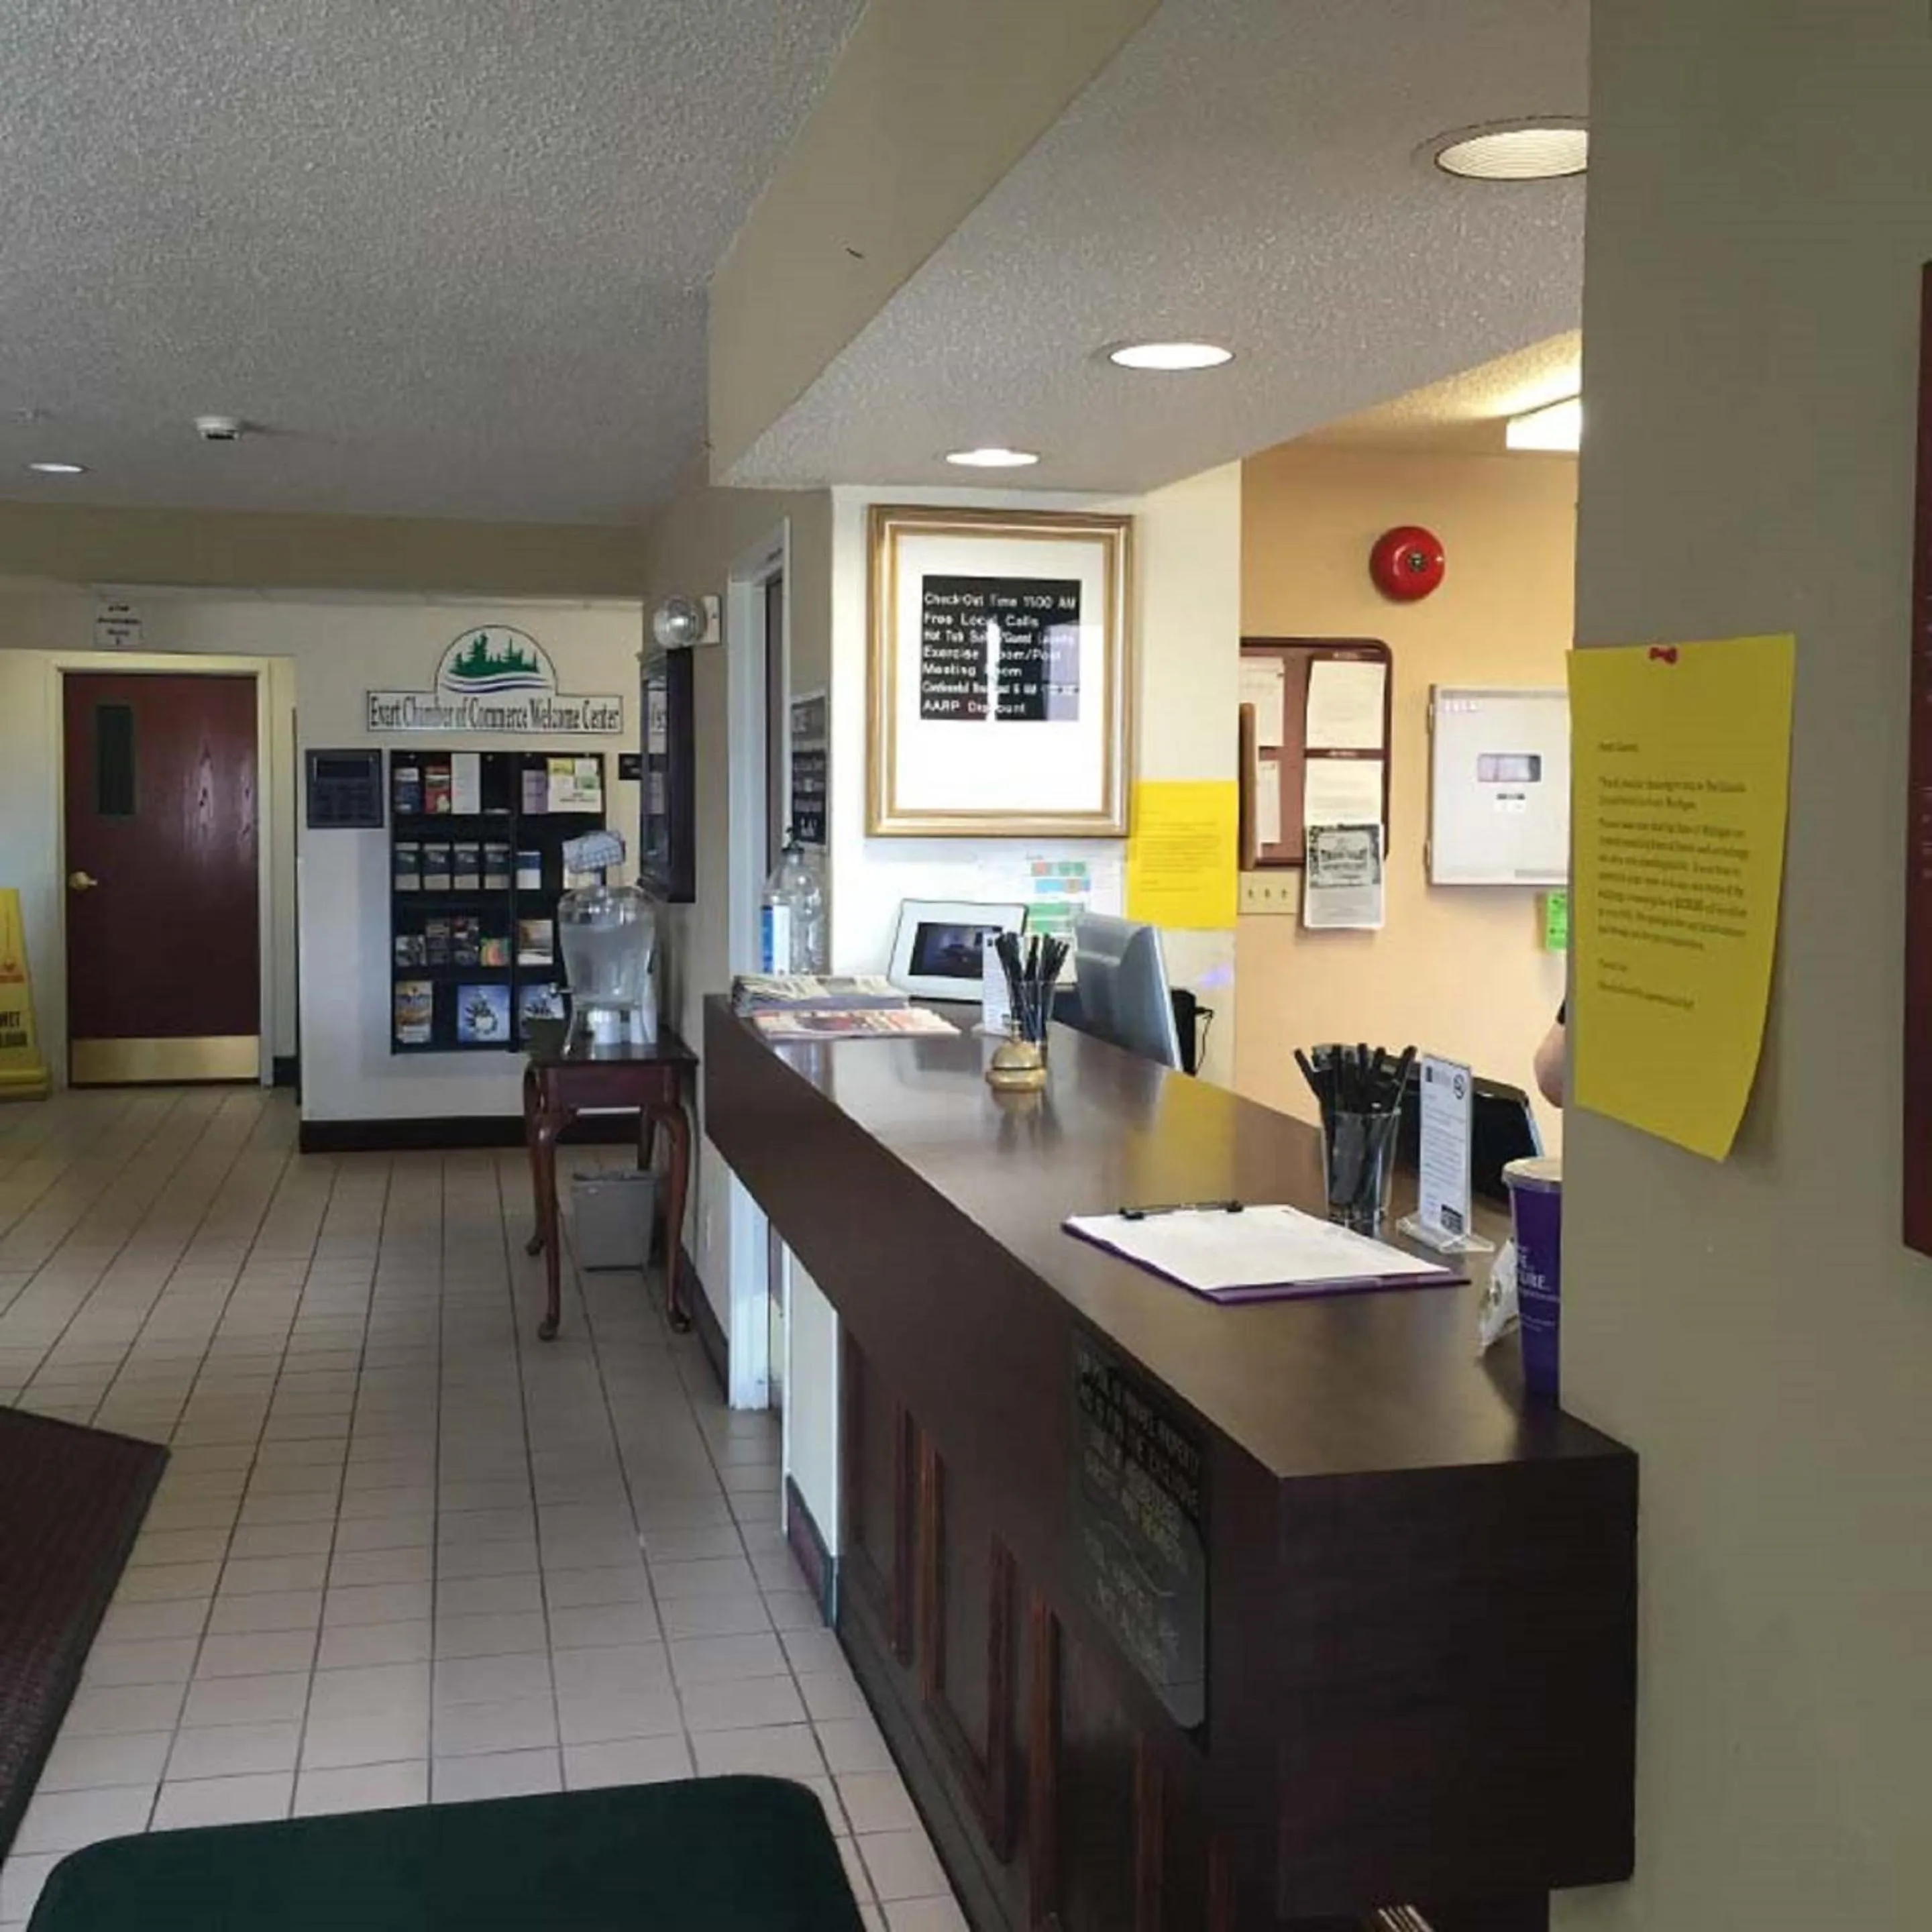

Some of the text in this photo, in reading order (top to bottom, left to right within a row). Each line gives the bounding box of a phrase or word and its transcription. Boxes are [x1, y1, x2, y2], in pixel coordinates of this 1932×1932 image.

[1059, 596, 1076, 609] AM
[925, 612, 953, 625] Free
[1006, 614, 1039, 628] Calls
[923, 661, 1022, 678] Meeting oom
[469, 696, 528, 728] Commerce
[529, 698, 580, 729] Welcome
[582, 700, 620, 729] Center
[922, 699, 1026, 714] AARP Disount
